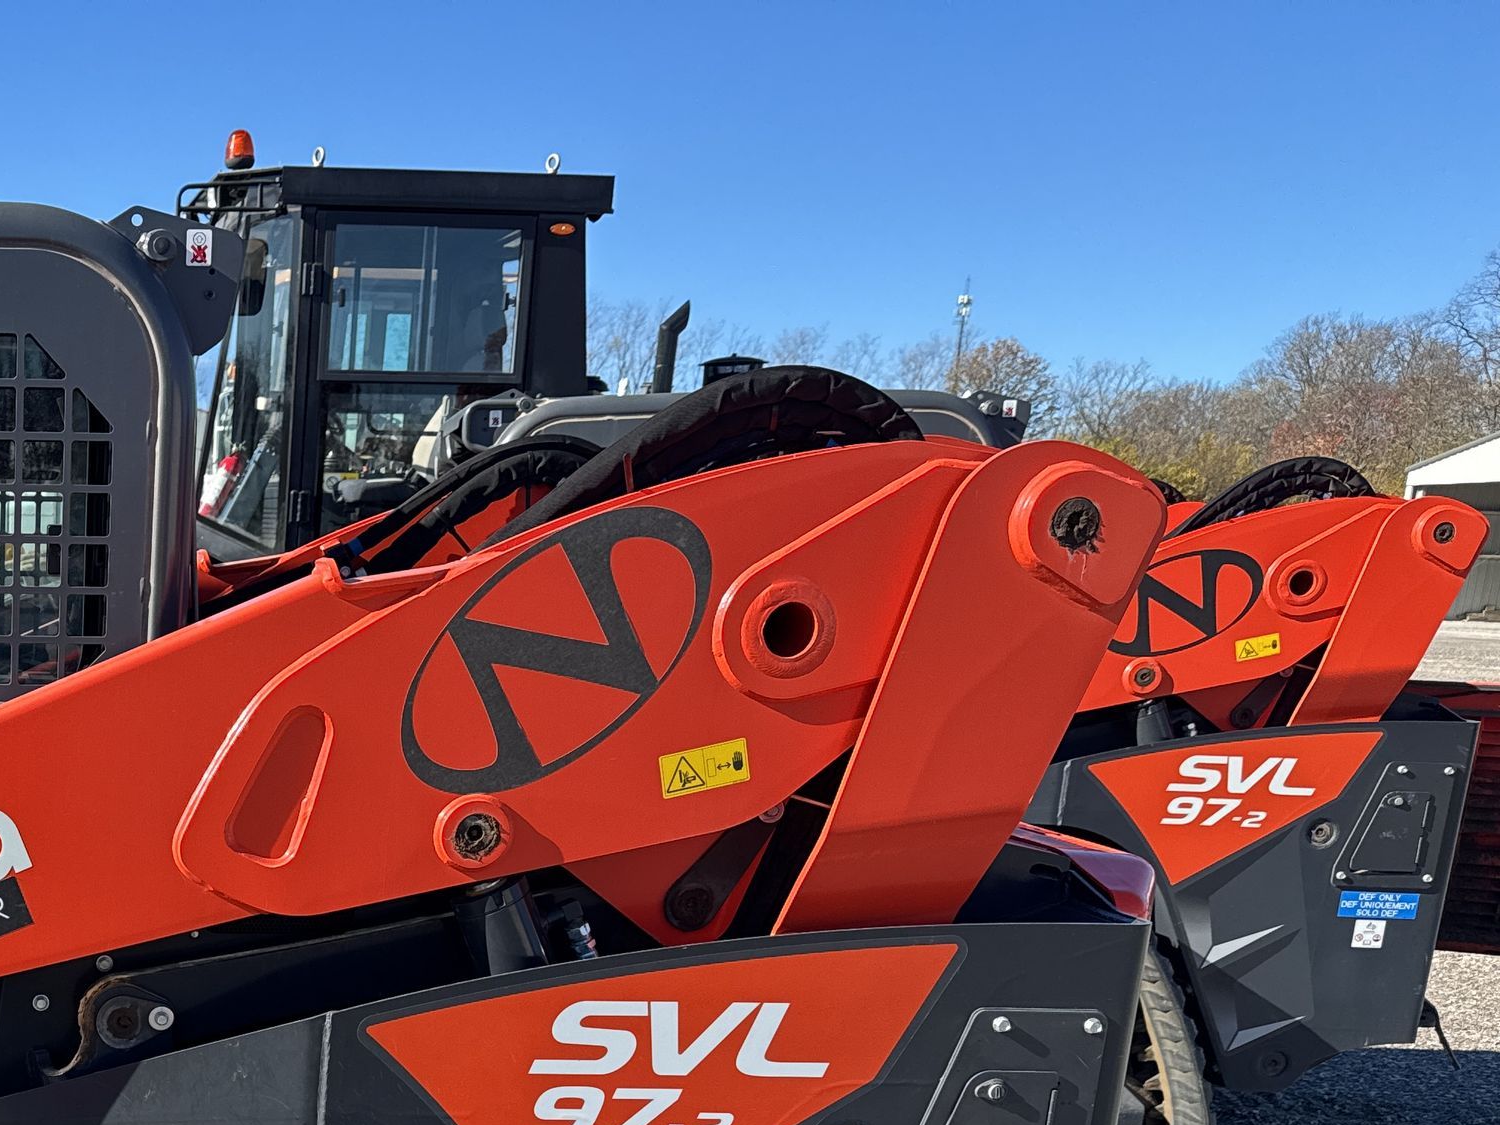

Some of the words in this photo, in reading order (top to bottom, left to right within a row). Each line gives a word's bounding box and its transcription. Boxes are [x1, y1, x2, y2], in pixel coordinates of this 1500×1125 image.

[1166, 754, 1316, 797] SVL
[1160, 796, 1268, 829] 97-2
[1358, 893, 1377, 901] DEF
[1379, 894, 1401, 902] ONLY
[1360, 901, 1417, 911] UNIQUEMENT
[528, 1001, 830, 1078] SVL
